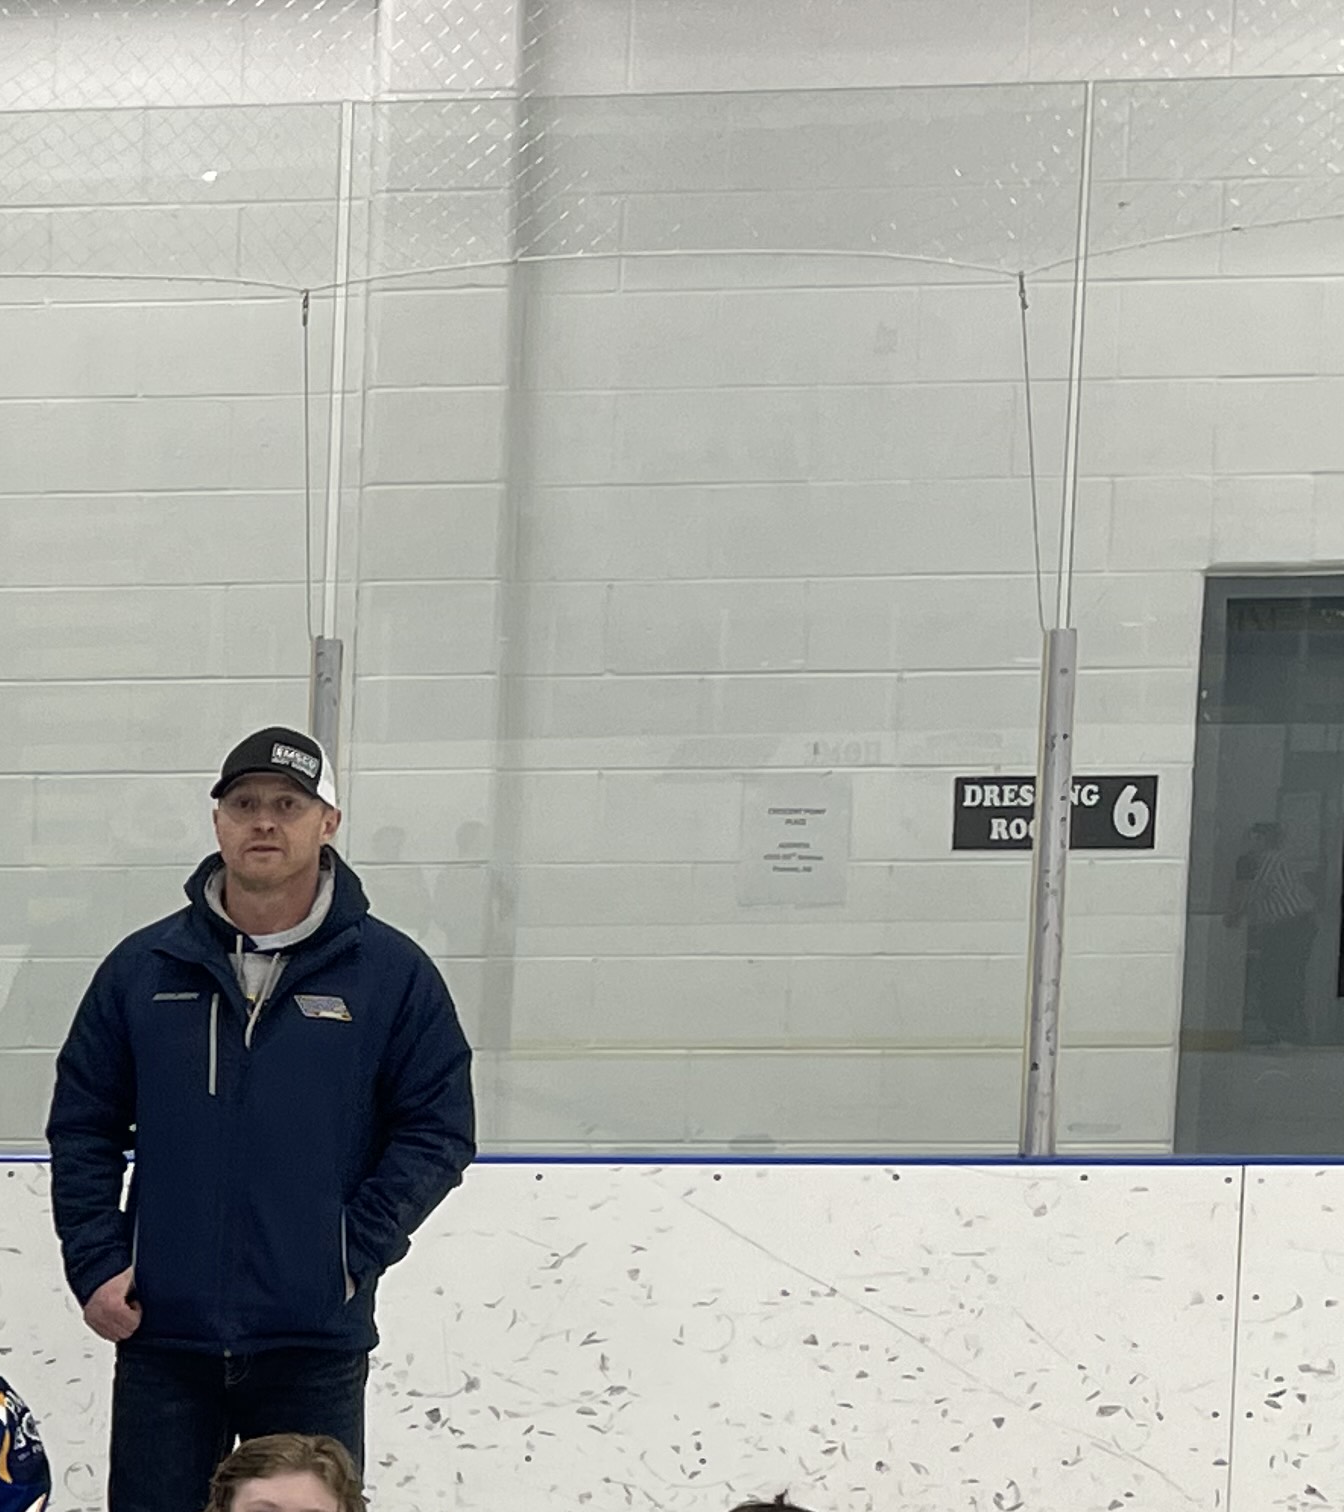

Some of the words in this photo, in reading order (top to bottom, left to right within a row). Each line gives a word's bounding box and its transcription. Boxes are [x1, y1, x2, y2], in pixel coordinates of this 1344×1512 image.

[962, 784, 1100, 807] DRESNG
[1113, 785, 1150, 838] 6
[989, 818, 1035, 840] RO
